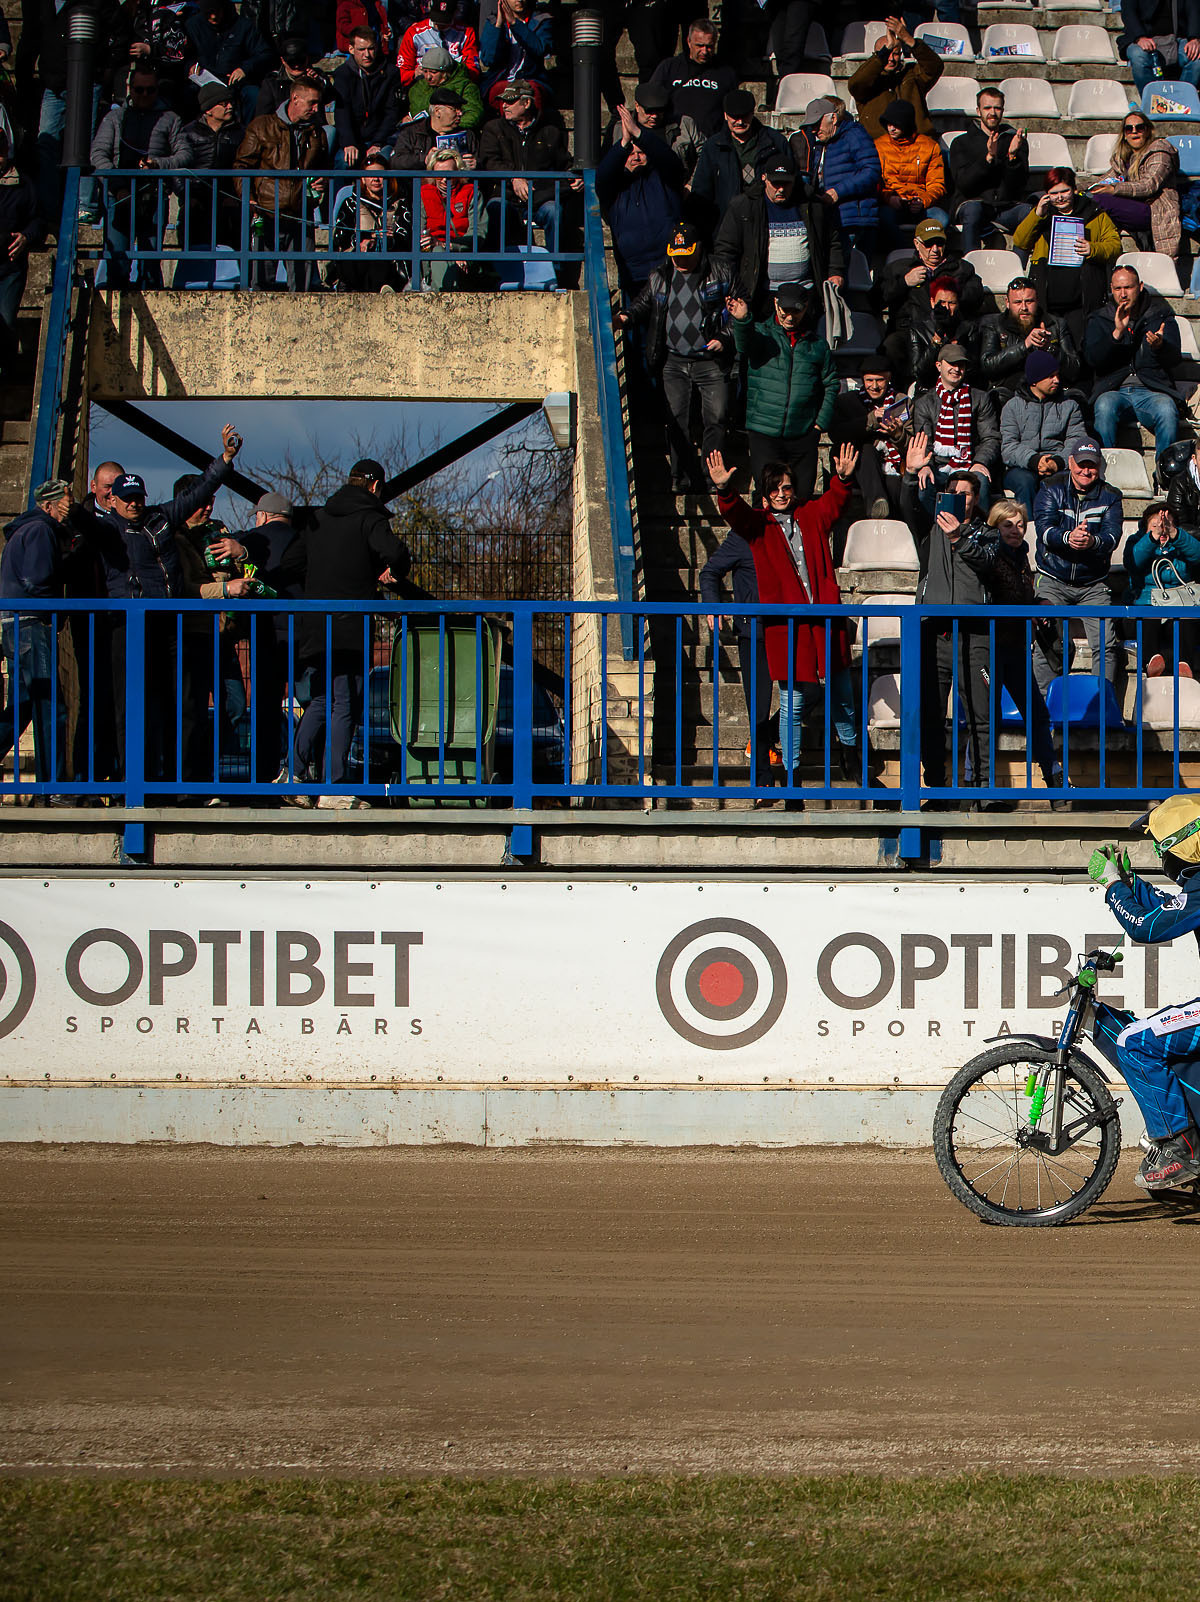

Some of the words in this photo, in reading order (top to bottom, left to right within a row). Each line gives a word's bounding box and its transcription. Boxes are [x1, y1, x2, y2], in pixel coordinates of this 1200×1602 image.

[711, 7, 721, 20] 2
[1160, 85, 1172, 93] 41
[1179, 139, 1191, 148] 41
[65, 928, 423, 1007] OPTIBET
[817, 932, 1173, 1010] OPTIBET
[66, 1017, 262, 1034] SPORTA
[302, 1013, 423, 1035] BĀRS
[818, 1020, 1012, 1037] SPORTA
